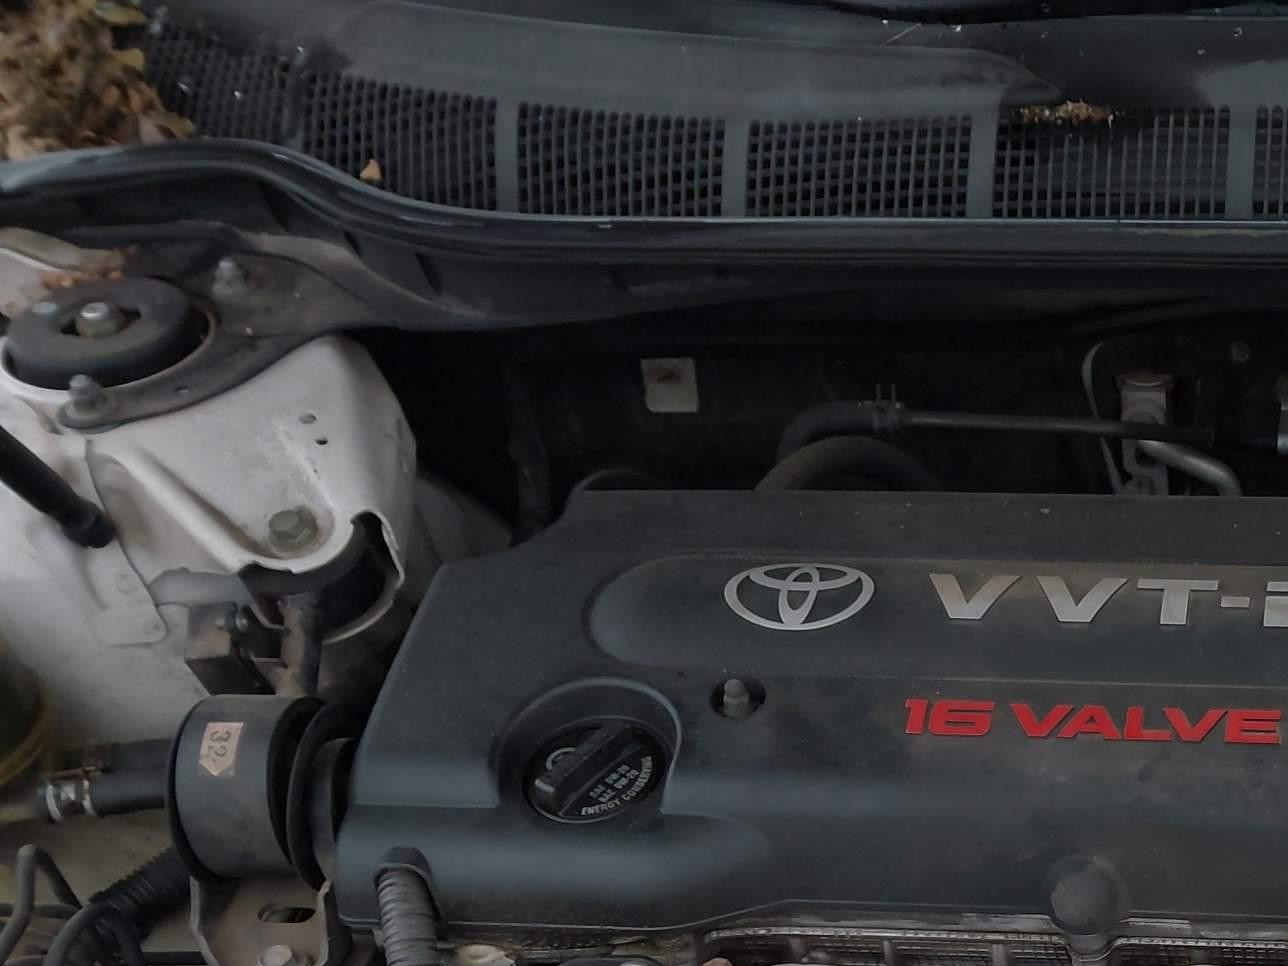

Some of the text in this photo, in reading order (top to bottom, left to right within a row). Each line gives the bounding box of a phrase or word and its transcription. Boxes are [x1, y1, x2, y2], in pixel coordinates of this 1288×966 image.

[905, 698, 1282, 745] 16 VALVE
[581, 797, 622, 816] ENERGY
